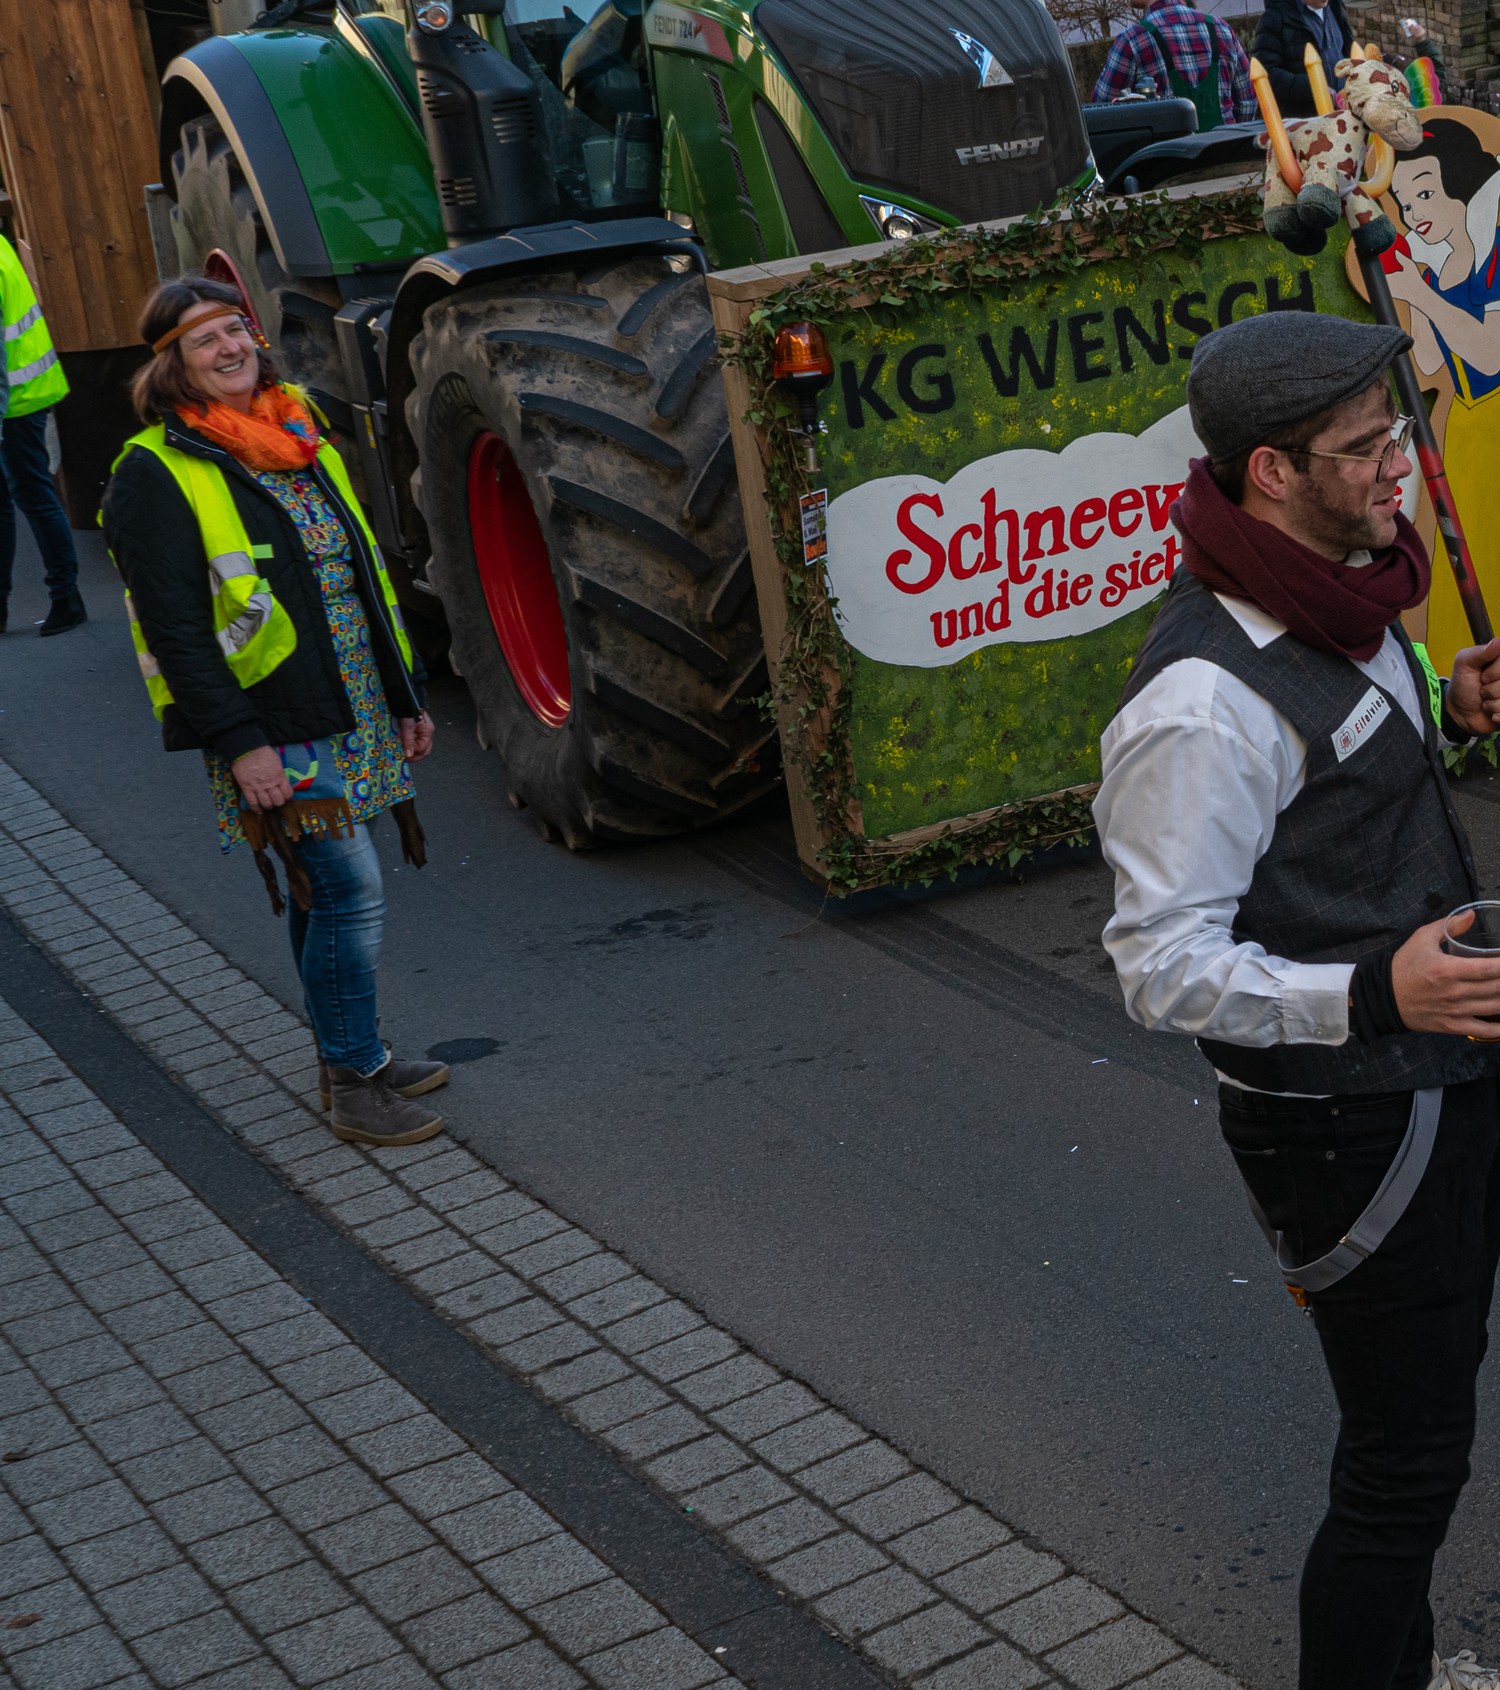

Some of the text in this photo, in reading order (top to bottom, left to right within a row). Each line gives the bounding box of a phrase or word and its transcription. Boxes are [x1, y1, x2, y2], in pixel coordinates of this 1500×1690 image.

[654, 15, 693, 40] FENDT 724
[955, 136, 1045, 166] FENDT
[840, 343, 956, 429] KG
[930, 578, 1011, 648] und
[1024, 568, 1094, 619] die
[1354, 696, 1385, 734] Eifelviez
